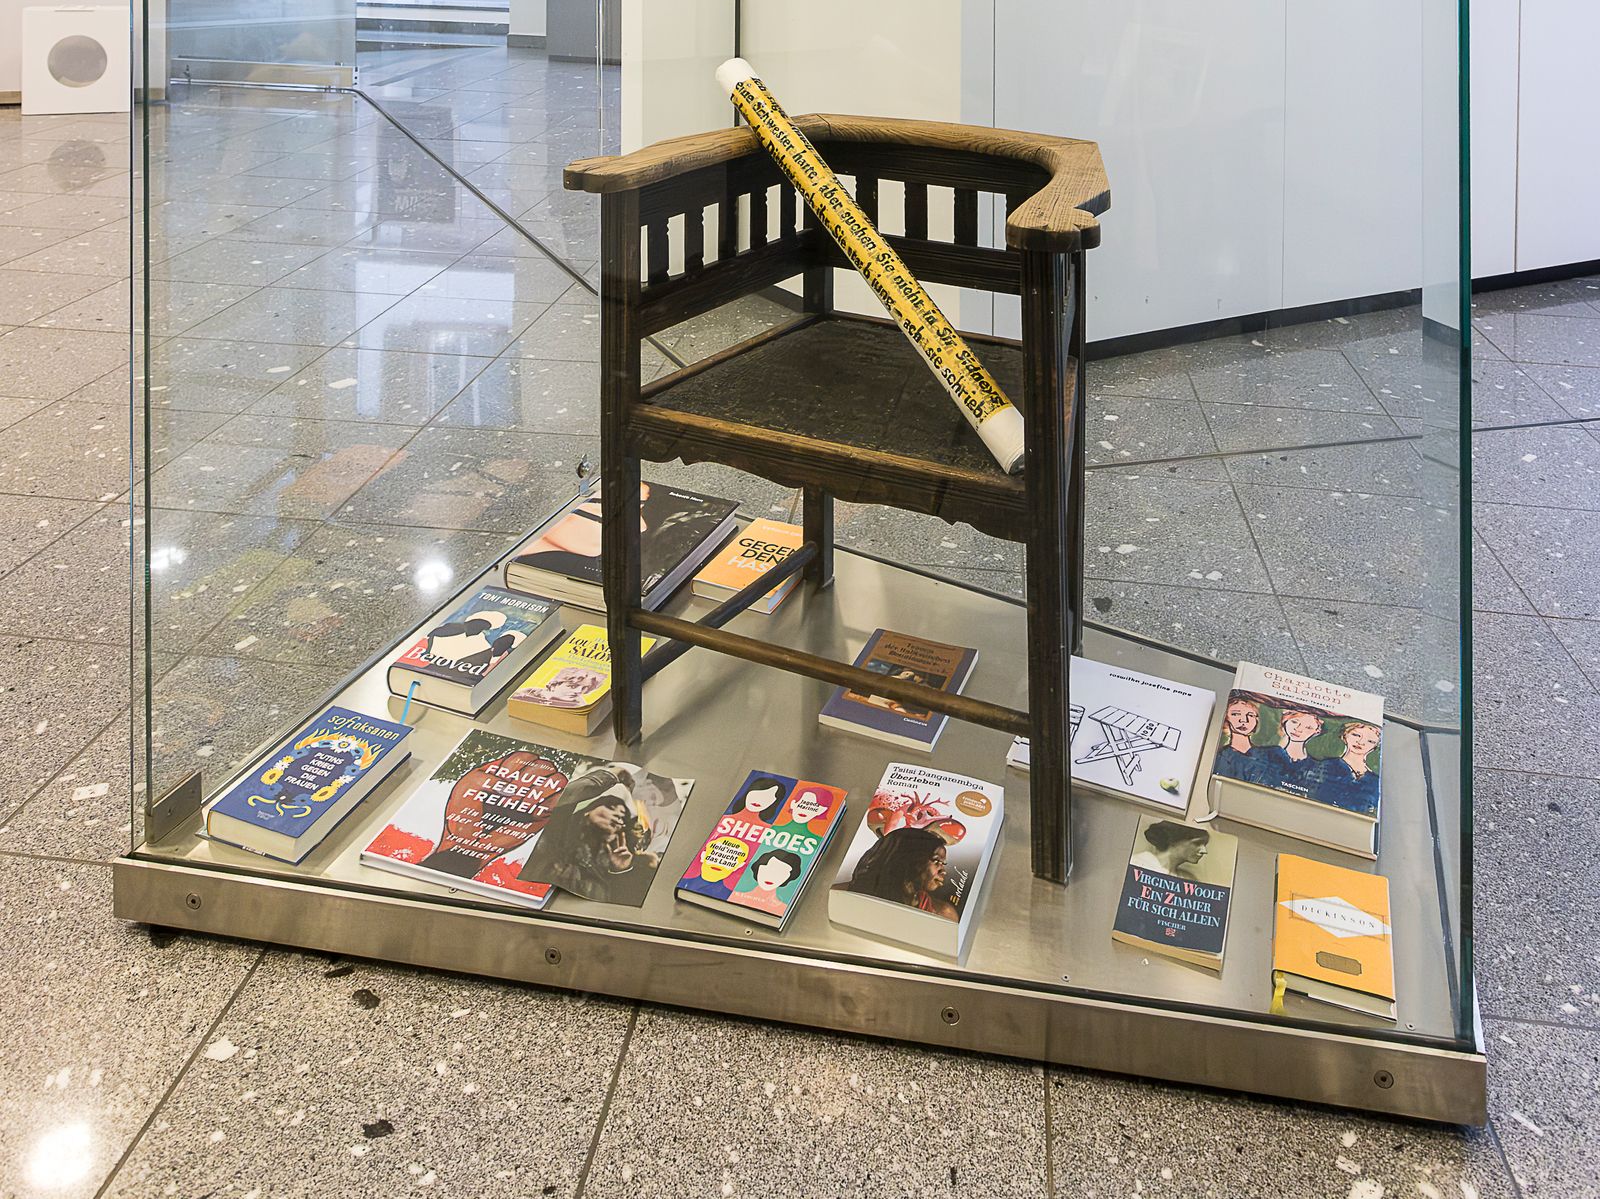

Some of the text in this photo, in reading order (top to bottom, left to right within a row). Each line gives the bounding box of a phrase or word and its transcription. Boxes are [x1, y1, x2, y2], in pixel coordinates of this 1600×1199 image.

[736, 82, 755, 104] eine
[752, 100, 795, 151] Schwester
[819, 184, 843, 209] aber
[842, 211, 876, 251] suchen
[877, 252, 895, 272] Sie
[894, 276, 924, 308] nicht
[936, 326, 958, 348] Sir
[925, 347, 943, 370] sie
[727, 556, 771, 572] HAS
[741, 548, 785, 564] DEN
[478, 592, 550, 614] TONI MORRISON
[404, 645, 488, 676] Beloved
[1264, 671, 1352, 699] Charlotte
[1271, 680, 1342, 705] Salomon
[309, 758, 335, 770] KRIEG
[314, 752, 344, 765] PUTINS
[301, 764, 332, 778] GEGEN
[301, 772, 316, 782] DIE
[485, 764, 562, 792] FRAUEN,
[890, 772, 941, 788] Überleben
[892, 766, 984, 791] Tsitsi Dangarembga
[284, 776, 320, 791] FRAUEN
[482, 778, 545, 804] LEBEN,
[886, 779, 918, 790] Roman
[1281, 780, 1309, 792] TASCHEN
[462, 788, 550, 816] FREIHEIT
[800, 798, 820, 808] Jagoda
[460, 807, 533, 830] Ein Bildband
[472, 830, 493, 840] der
[473, 820, 494, 830] den
[495, 826, 535, 841] Kampf
[716, 817, 818, 856] SHEROES
[450, 844, 491, 860] Frauen
[722, 840, 741, 850] Neue
[706, 856, 737, 868] das Land
[710, 850, 738, 862] braucht
[1133, 868, 1226, 901] VIRGINIA WOOLF
[1140, 885, 1211, 913] EIN ZIMMER
[1128, 896, 1221, 928] FÜR SICH ALLEIN
[1300, 904, 1376, 929] DICKINSON
[1157, 919, 1187, 931] FISCHER
